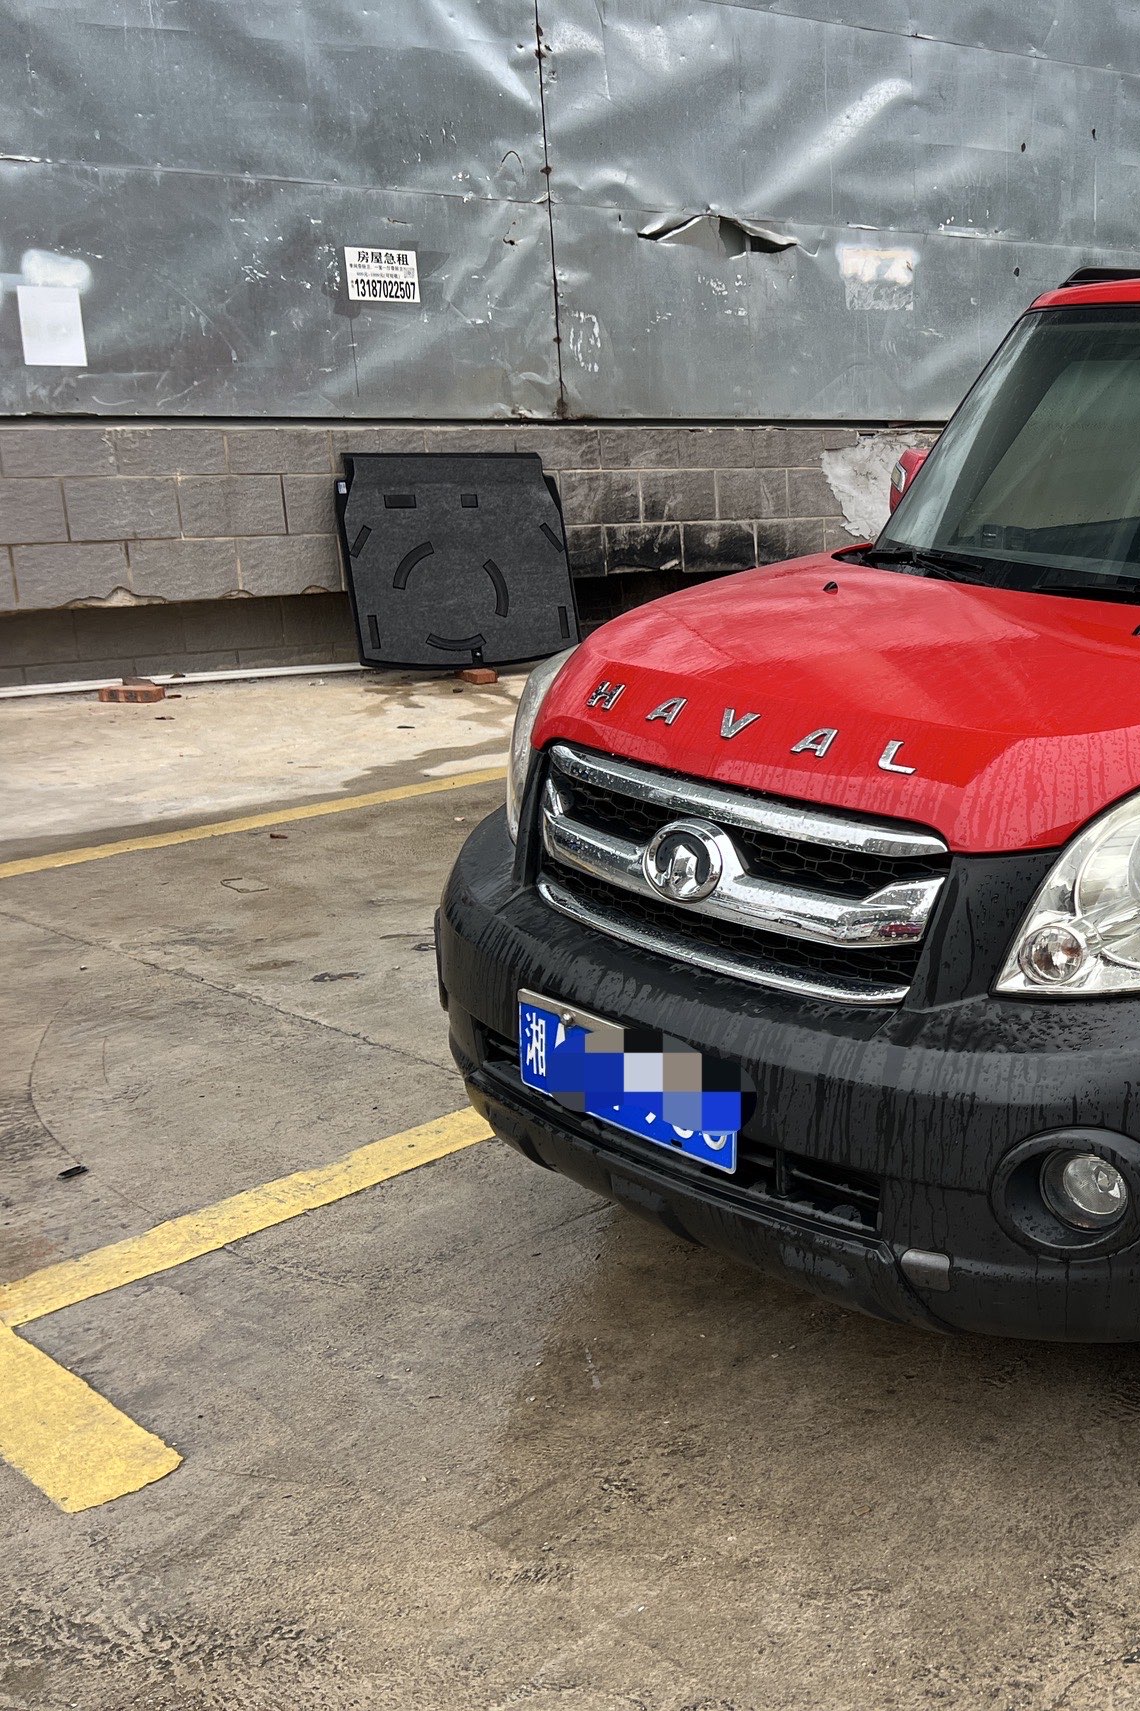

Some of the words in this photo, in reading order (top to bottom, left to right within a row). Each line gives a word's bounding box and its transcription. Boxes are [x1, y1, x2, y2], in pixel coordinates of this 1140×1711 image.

[357, 250, 409, 266] 房屋急租
[355, 278, 416, 300] 13187022507
[586, 681, 917, 775] HAVAL
